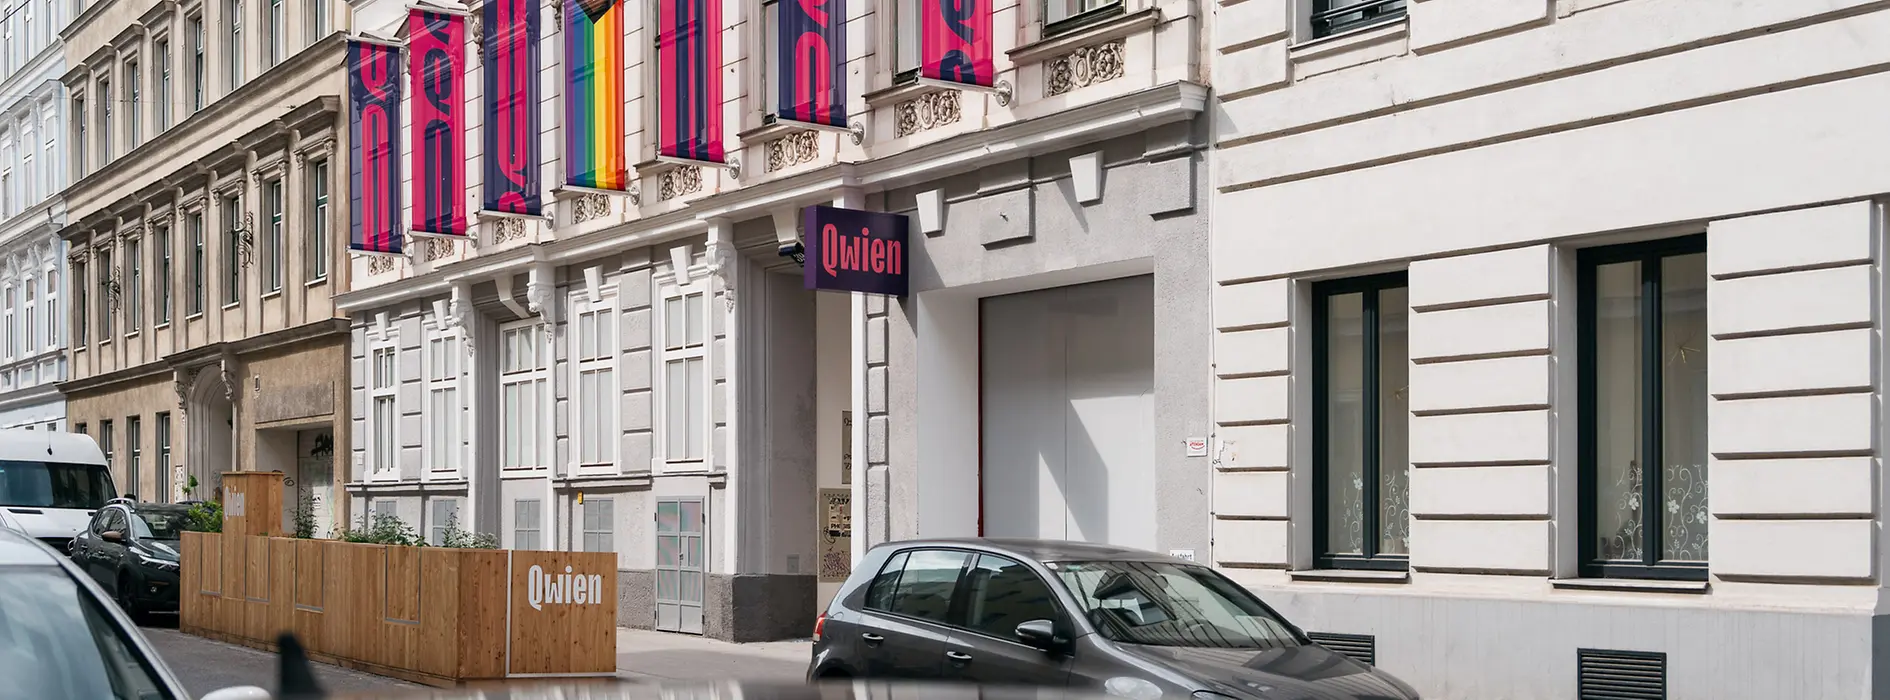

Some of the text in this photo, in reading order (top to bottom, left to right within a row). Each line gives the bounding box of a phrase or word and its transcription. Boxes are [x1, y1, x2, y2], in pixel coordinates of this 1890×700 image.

[822, 223, 901, 277] Qwien
[224, 486, 245, 521] Qwien
[528, 564, 602, 612] Qwien
